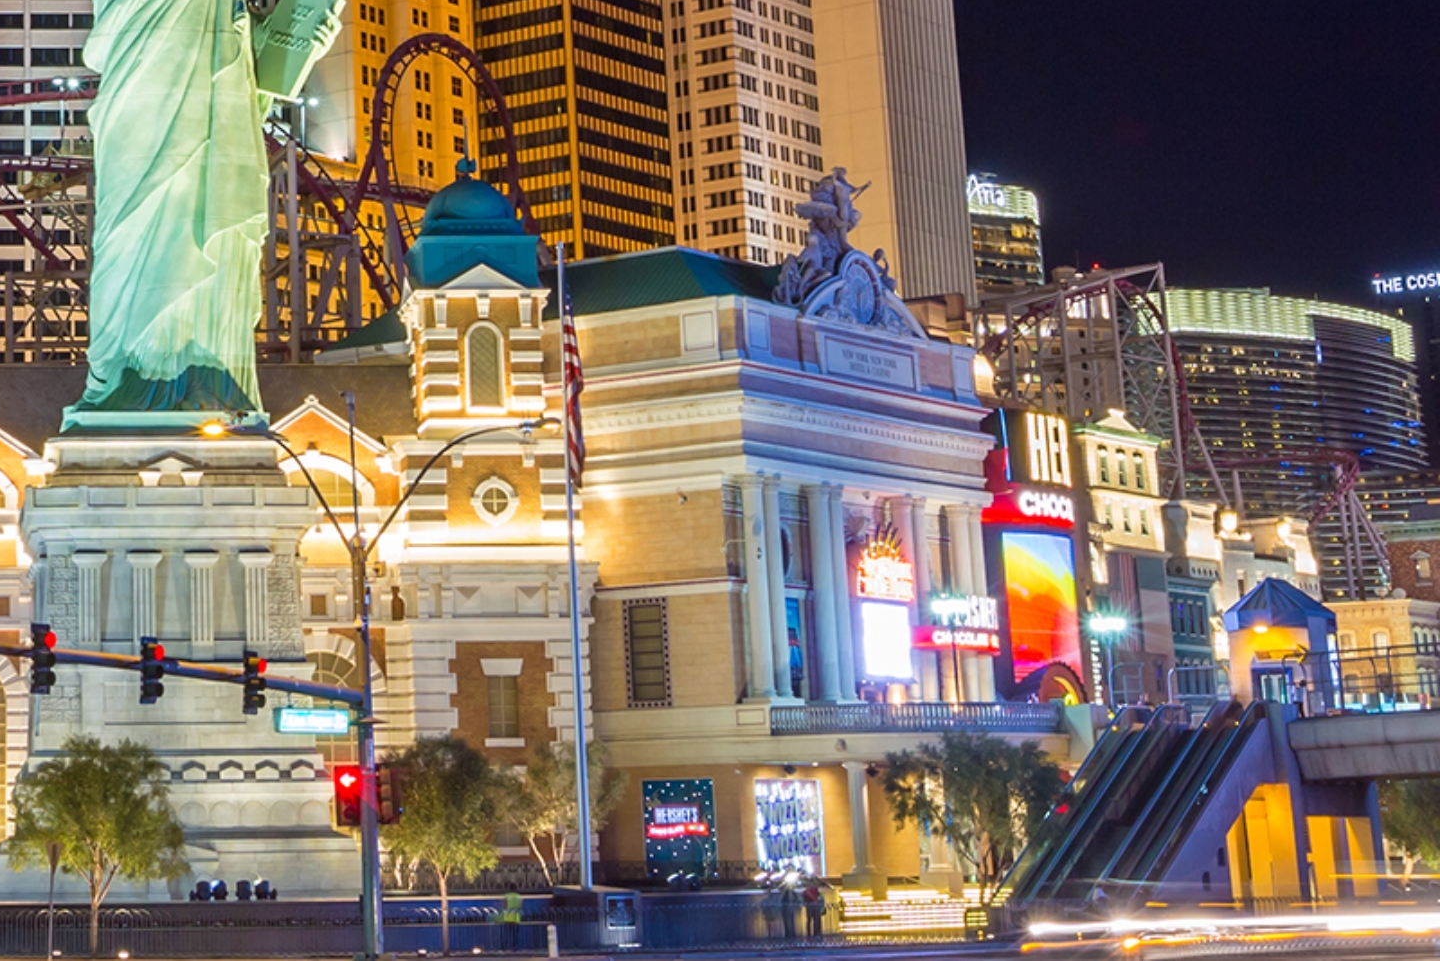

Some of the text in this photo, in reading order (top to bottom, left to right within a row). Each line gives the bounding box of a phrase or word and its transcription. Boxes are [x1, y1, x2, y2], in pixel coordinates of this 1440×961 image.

[1372, 277, 1403, 294] THE
[842, 349, 897, 369] NEW YORK NEW YORK
[850, 361, 866, 373] HOTEL
